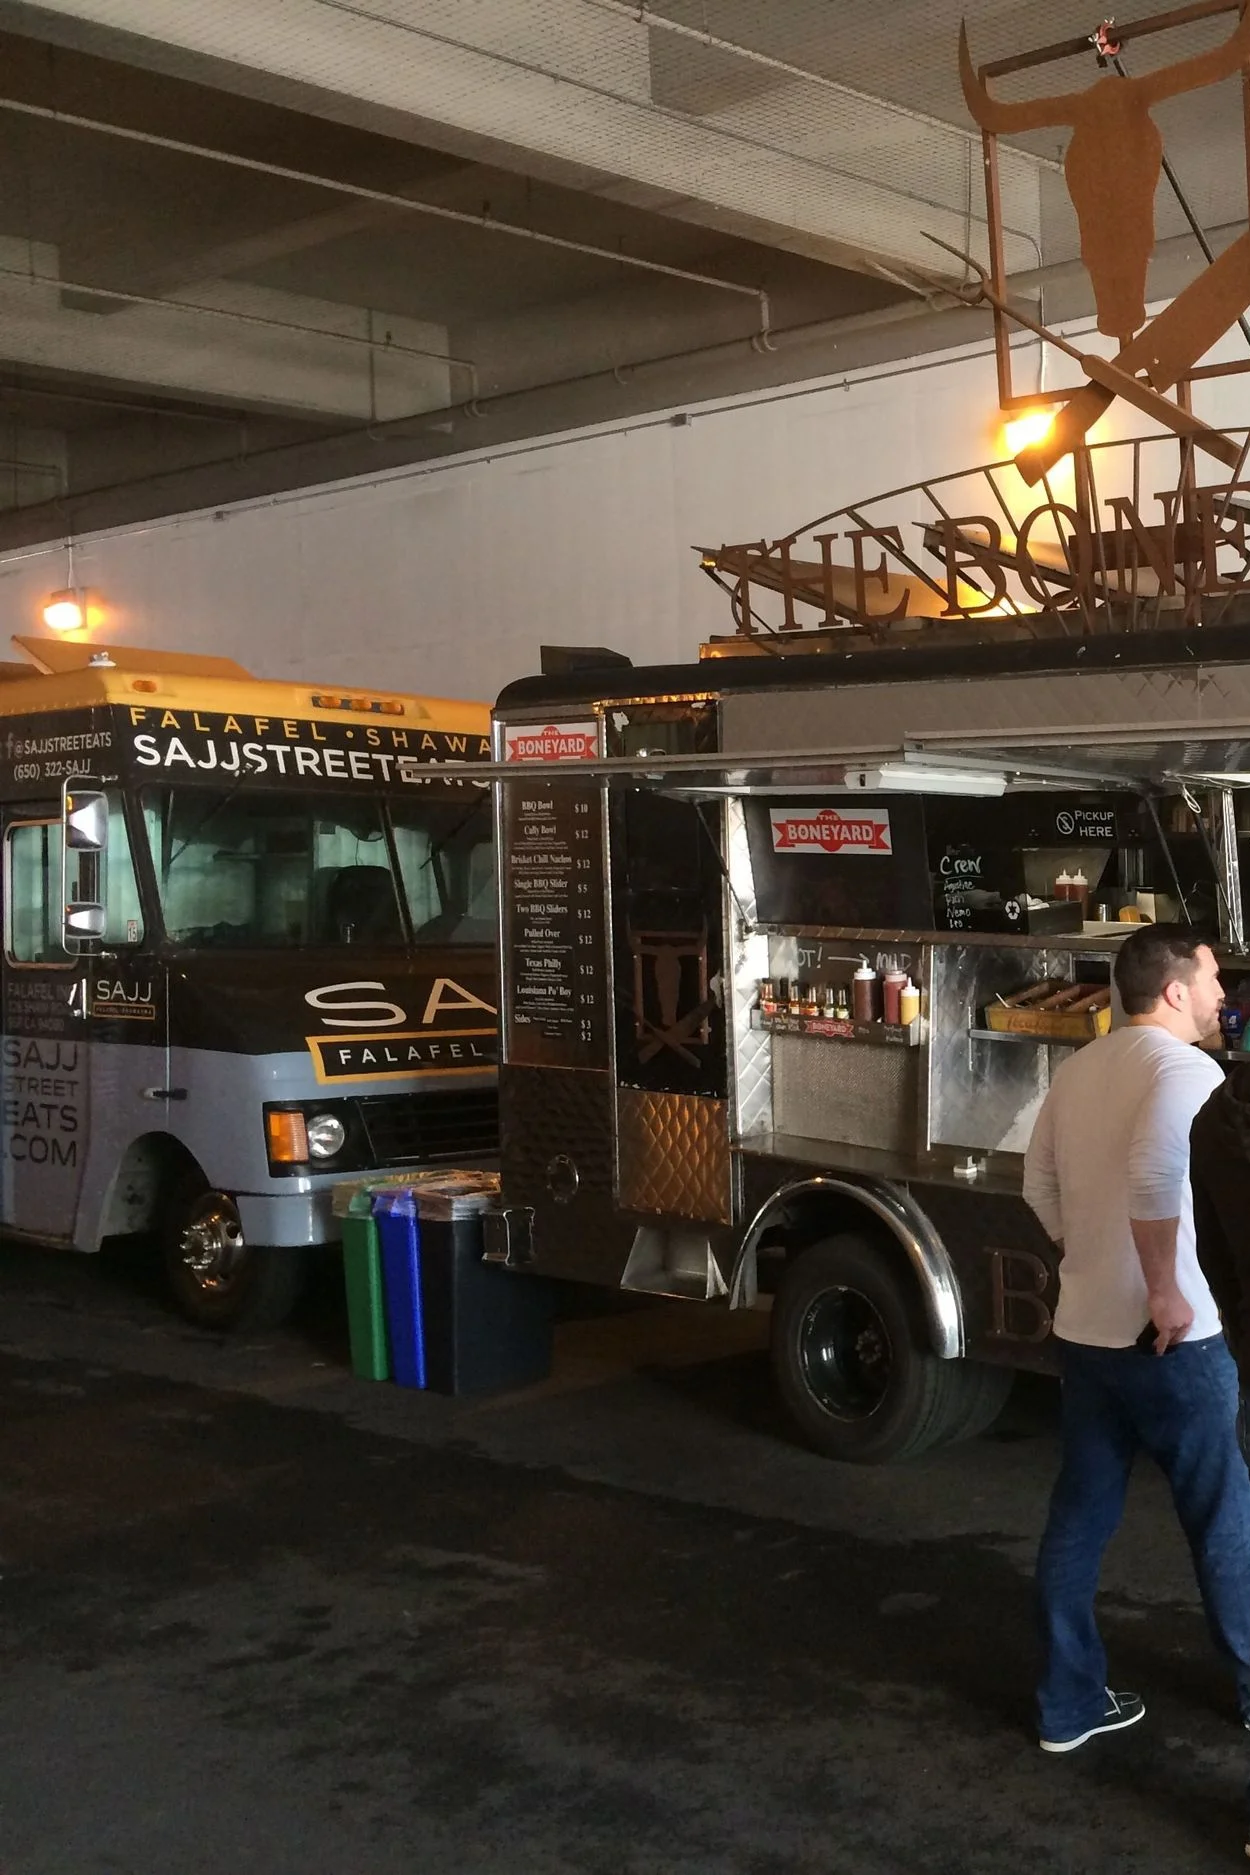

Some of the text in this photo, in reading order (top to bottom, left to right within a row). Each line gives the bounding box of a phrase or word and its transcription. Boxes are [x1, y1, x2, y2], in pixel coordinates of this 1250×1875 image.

[715, 524, 911, 634] THE
[130, 707, 327, 741] FALAFEL
[518, 737, 585, 756] BONEYARD
[14, 758, 91, 781] (650) 322-SAJJ
[133, 734, 491, 789] SAJJSTREETE
[818, 813, 840, 821] THE
[1074, 809, 1114, 822] PICKUP
[787, 824, 874, 842] BONEYARD
[1079, 826, 1113, 838] HERE
[940, 855, 982, 875] Crew
[96, 979, 153, 1002] SAJJ
[812, 1021, 848, 1034] BONEYARD
[3, 1040, 79, 1072] SAJJ
[338, 1042, 484, 1065] FALAFEL
[4, 1075, 79, 1097] STREET
[4, 1101, 79, 1133] EATS
